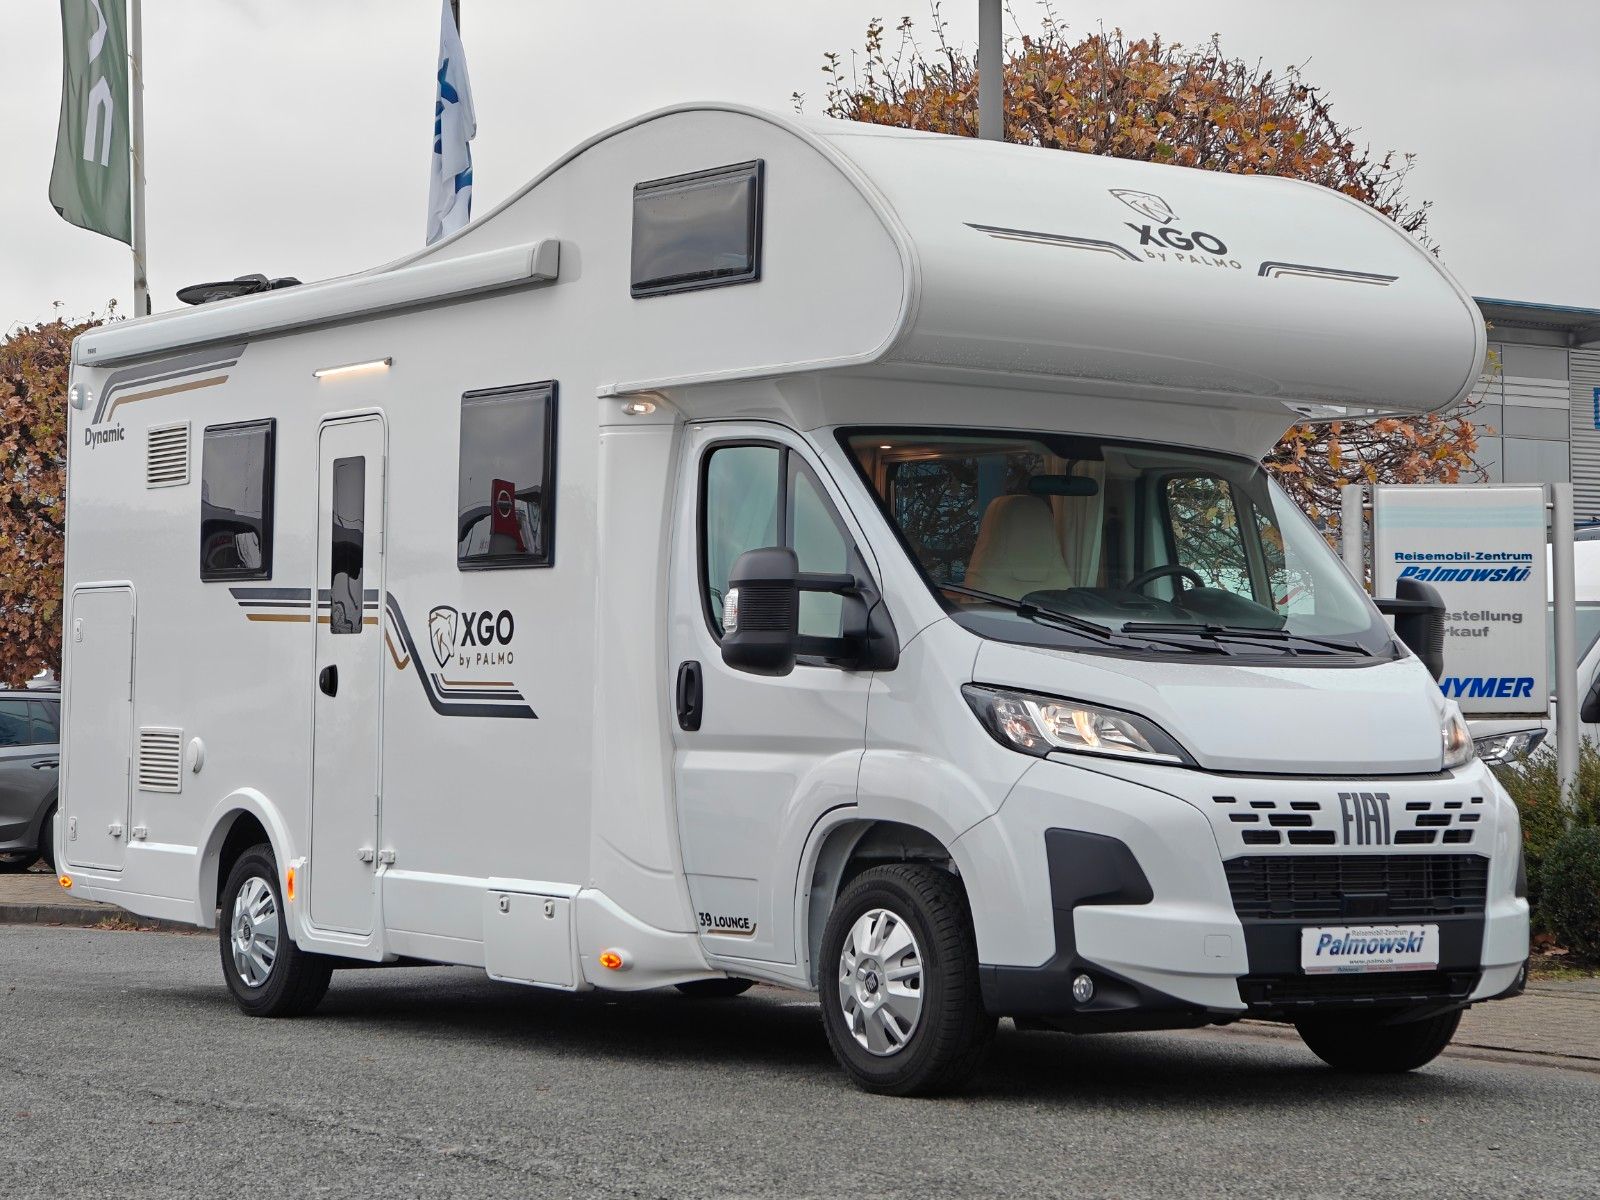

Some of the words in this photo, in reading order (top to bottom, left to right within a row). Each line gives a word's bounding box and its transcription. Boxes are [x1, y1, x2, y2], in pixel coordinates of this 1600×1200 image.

[1124, 221, 1228, 256] XGO
[1144, 249, 1166, 262] by
[1175, 252, 1242, 270] PALMO
[84, 422, 125, 450] Dynamic
[1395, 552, 1533, 561] Reisemobil-Zentrum
[1397, 566, 1532, 582] Palmowski
[461, 609, 514, 647] XGO
[459, 653, 471, 669] by
[476, 651, 514, 666] PALMO
[1337, 792, 1391, 846] FIAT
[699, 912, 712, 927] 39
[714, 915, 750, 929] LOUNGE
[1315, 931, 1426, 956] Palmowski
